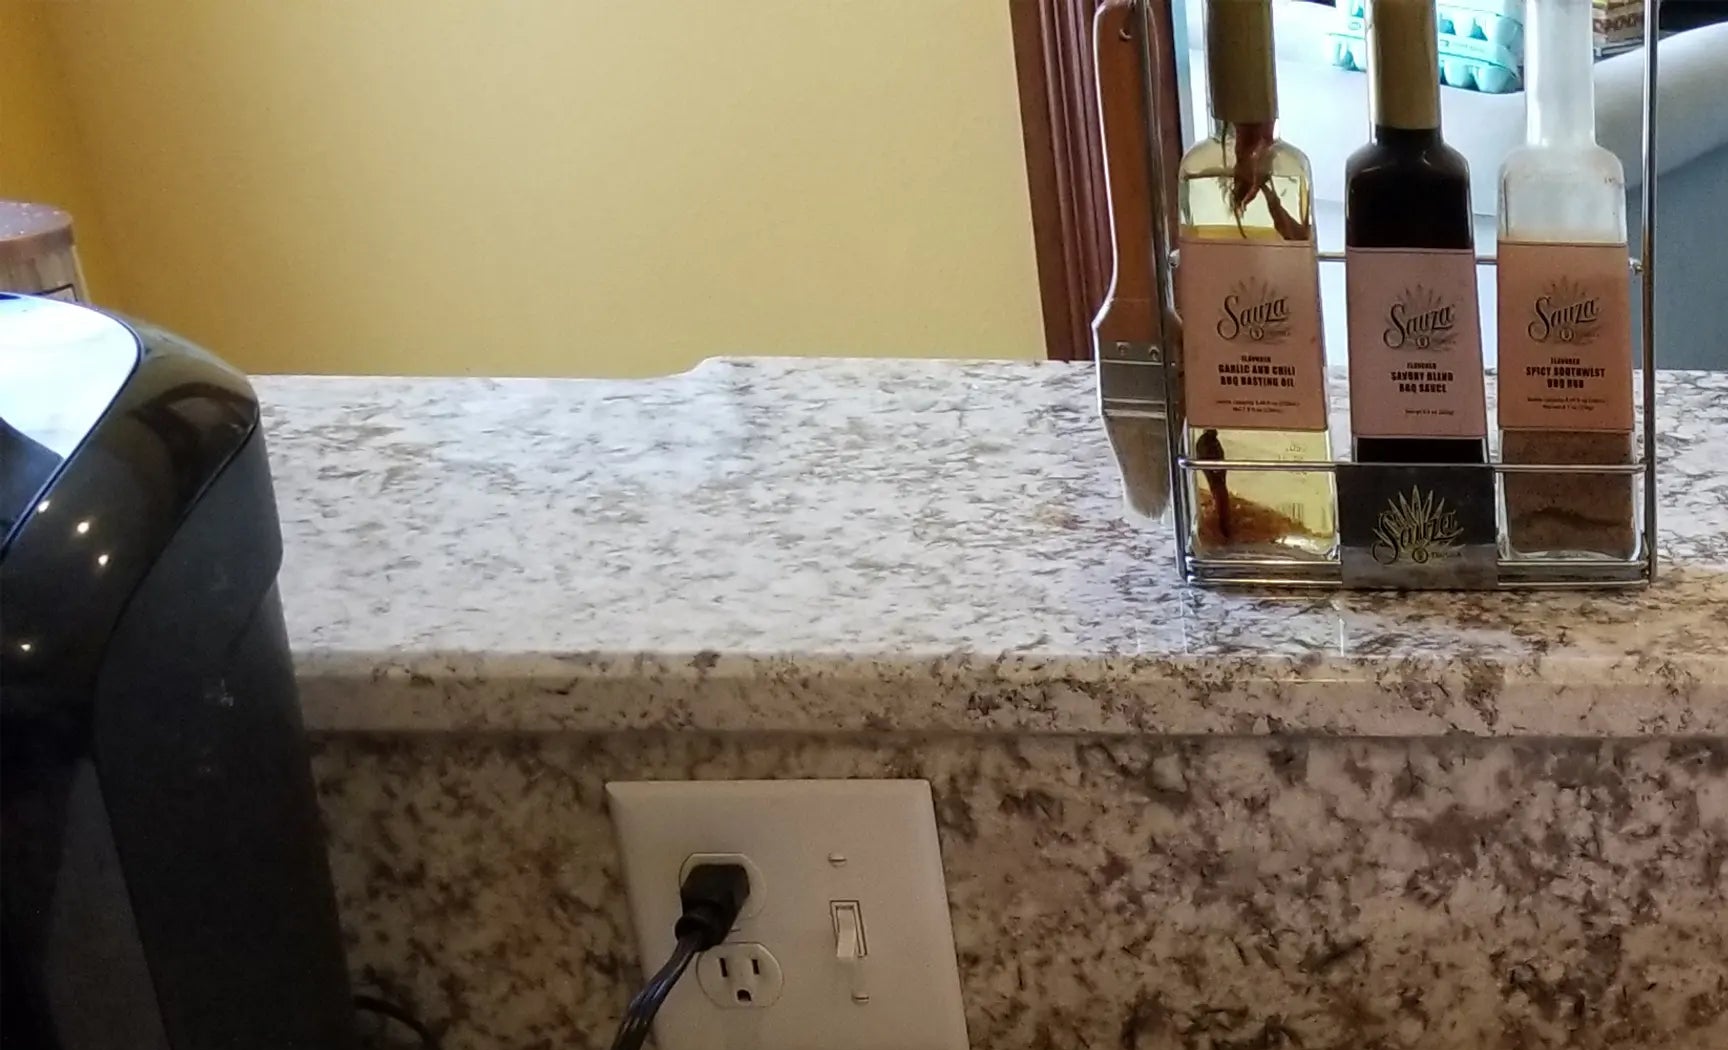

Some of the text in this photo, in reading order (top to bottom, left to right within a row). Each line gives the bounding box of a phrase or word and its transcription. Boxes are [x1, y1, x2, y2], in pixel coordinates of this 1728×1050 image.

[1216, 294, 1289, 341] Sauza
[1526, 296, 1598, 343] Sauza
[1383, 303, 1454, 349] Sauza
[1218, 364, 1295, 376] GARLIC AND CHILI
[1391, 371, 1454, 381] SAVORY BLEND
[1526, 366, 1605, 378] SPICY SOUTHWEST
[1220, 376, 1295, 388] BBQ BASTING OIL
[1547, 379, 1584, 389] BBQ RUB
[1399, 383, 1447, 394] BBQ SAUCE
[1370, 510, 1464, 566] Sauza
